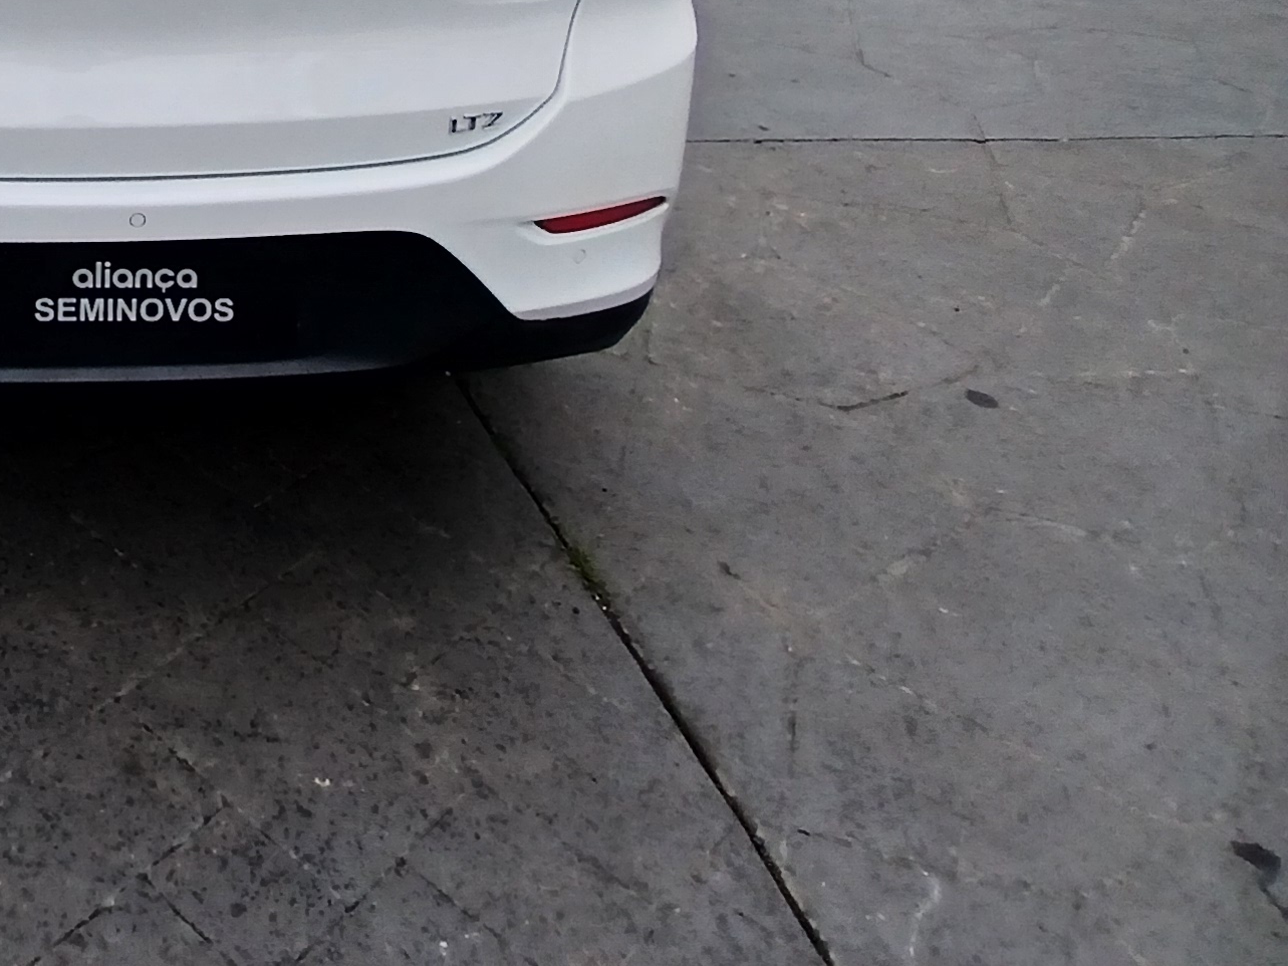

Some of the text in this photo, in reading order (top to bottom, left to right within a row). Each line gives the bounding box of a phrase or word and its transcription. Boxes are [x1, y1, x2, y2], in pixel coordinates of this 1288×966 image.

[449, 111, 504, 134] LTZ
[71, 261, 198, 293] aliança
[34, 297, 235, 322] SEMINOVOS
